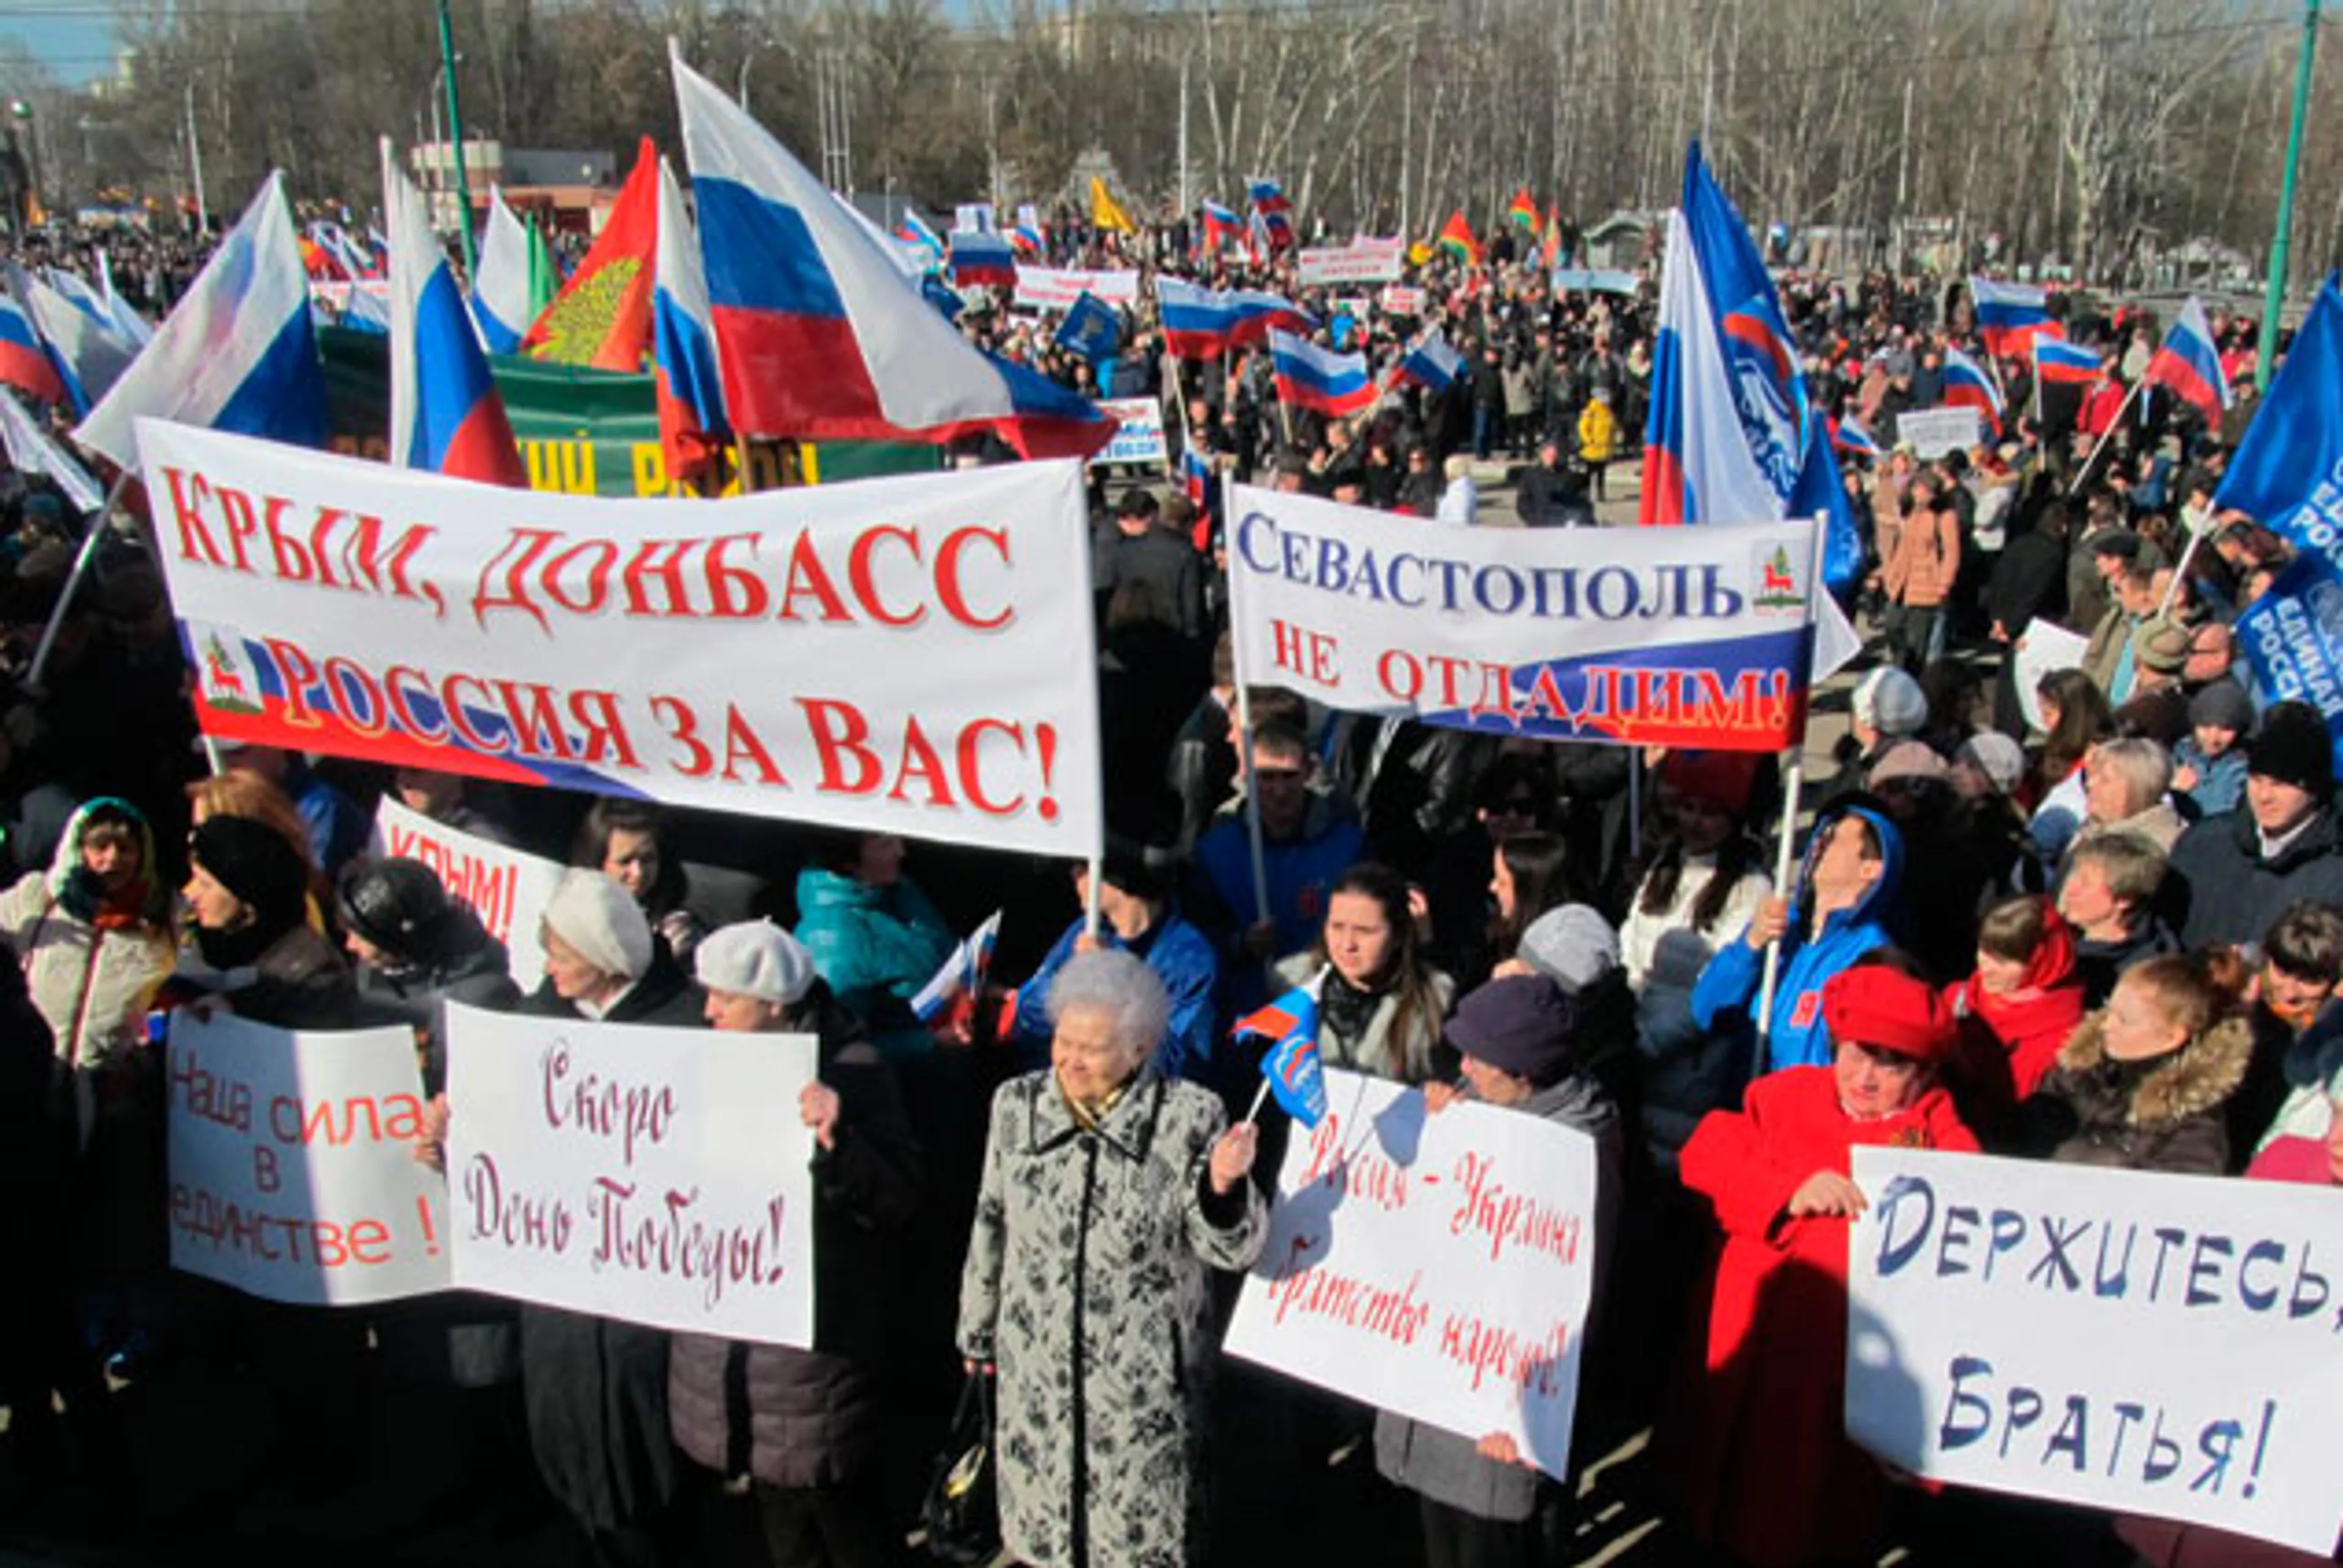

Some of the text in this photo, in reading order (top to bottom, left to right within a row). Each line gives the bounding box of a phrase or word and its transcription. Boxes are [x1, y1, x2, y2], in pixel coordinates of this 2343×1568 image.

[472, 523, 1015, 638] ДОНБАСС
[1270, 619, 1789, 731] НЕ ОТДАДИМ!
[650, 696, 791, 788] ЗА
[270, 1092, 425, 1146] сила
[541, 1038, 678, 1167] Скоро
[465, 1152, 785, 1312] День Победы!
